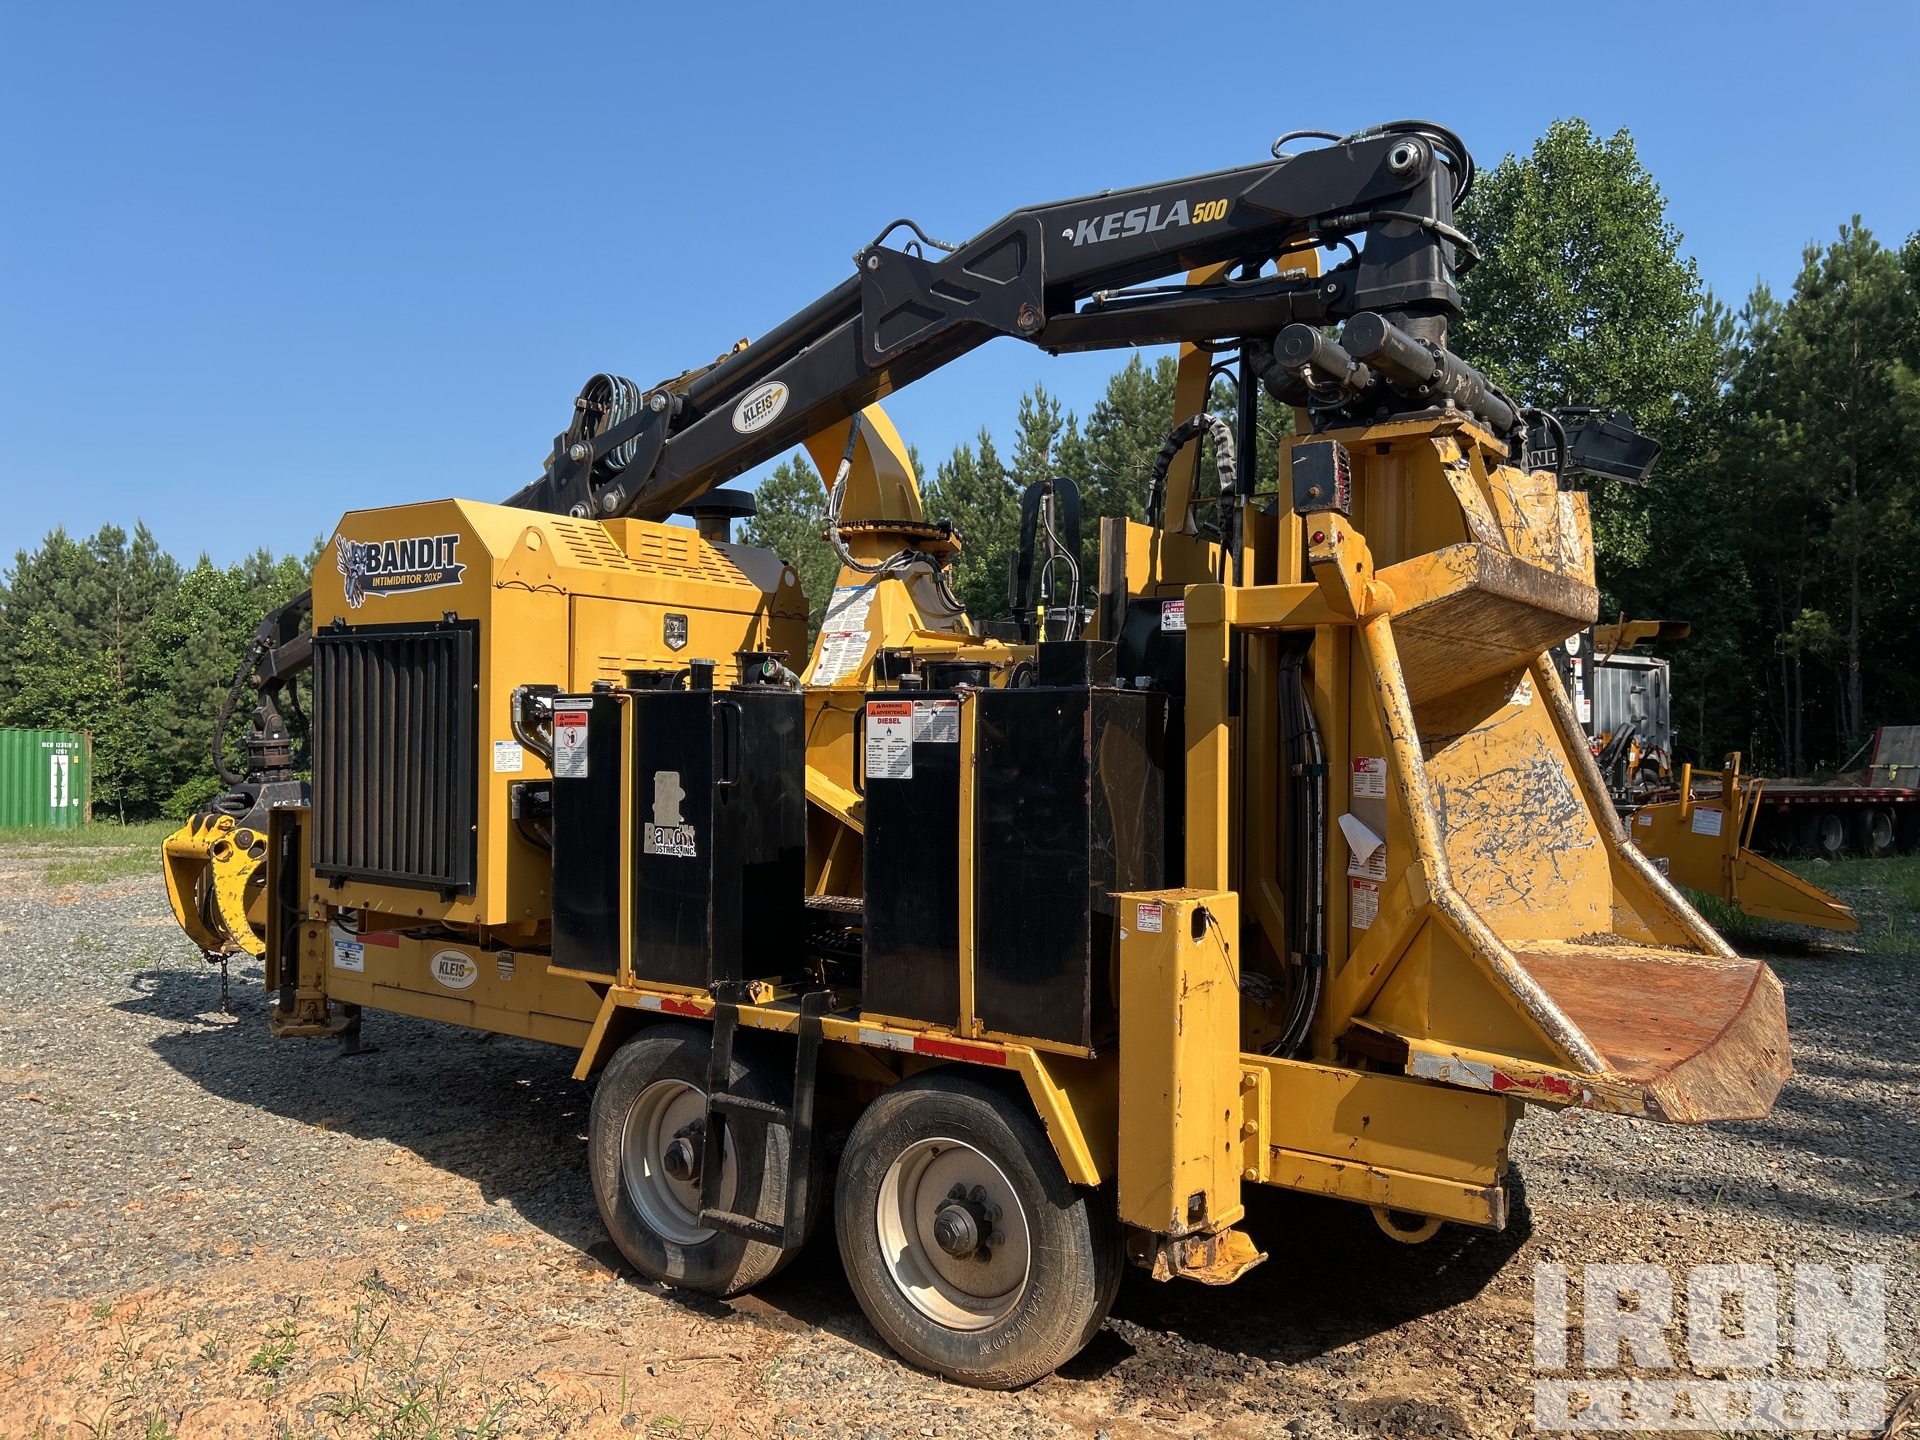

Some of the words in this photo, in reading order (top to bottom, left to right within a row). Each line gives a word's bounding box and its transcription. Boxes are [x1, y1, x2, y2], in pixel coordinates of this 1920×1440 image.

[1073, 199, 1191, 247] KESLA
[1191, 198, 1228, 225] 500
[743, 395, 773, 424] KLEIS
[364, 534, 460, 575] BANDIT
[372, 574, 421, 586] INTIMIDATOR
[424, 572, 443, 583] 20XP
[877, 717, 901, 725] DIESEL
[438, 961, 465, 977] KLEIS
[979, 1282, 1045, 1355] SAMSON
